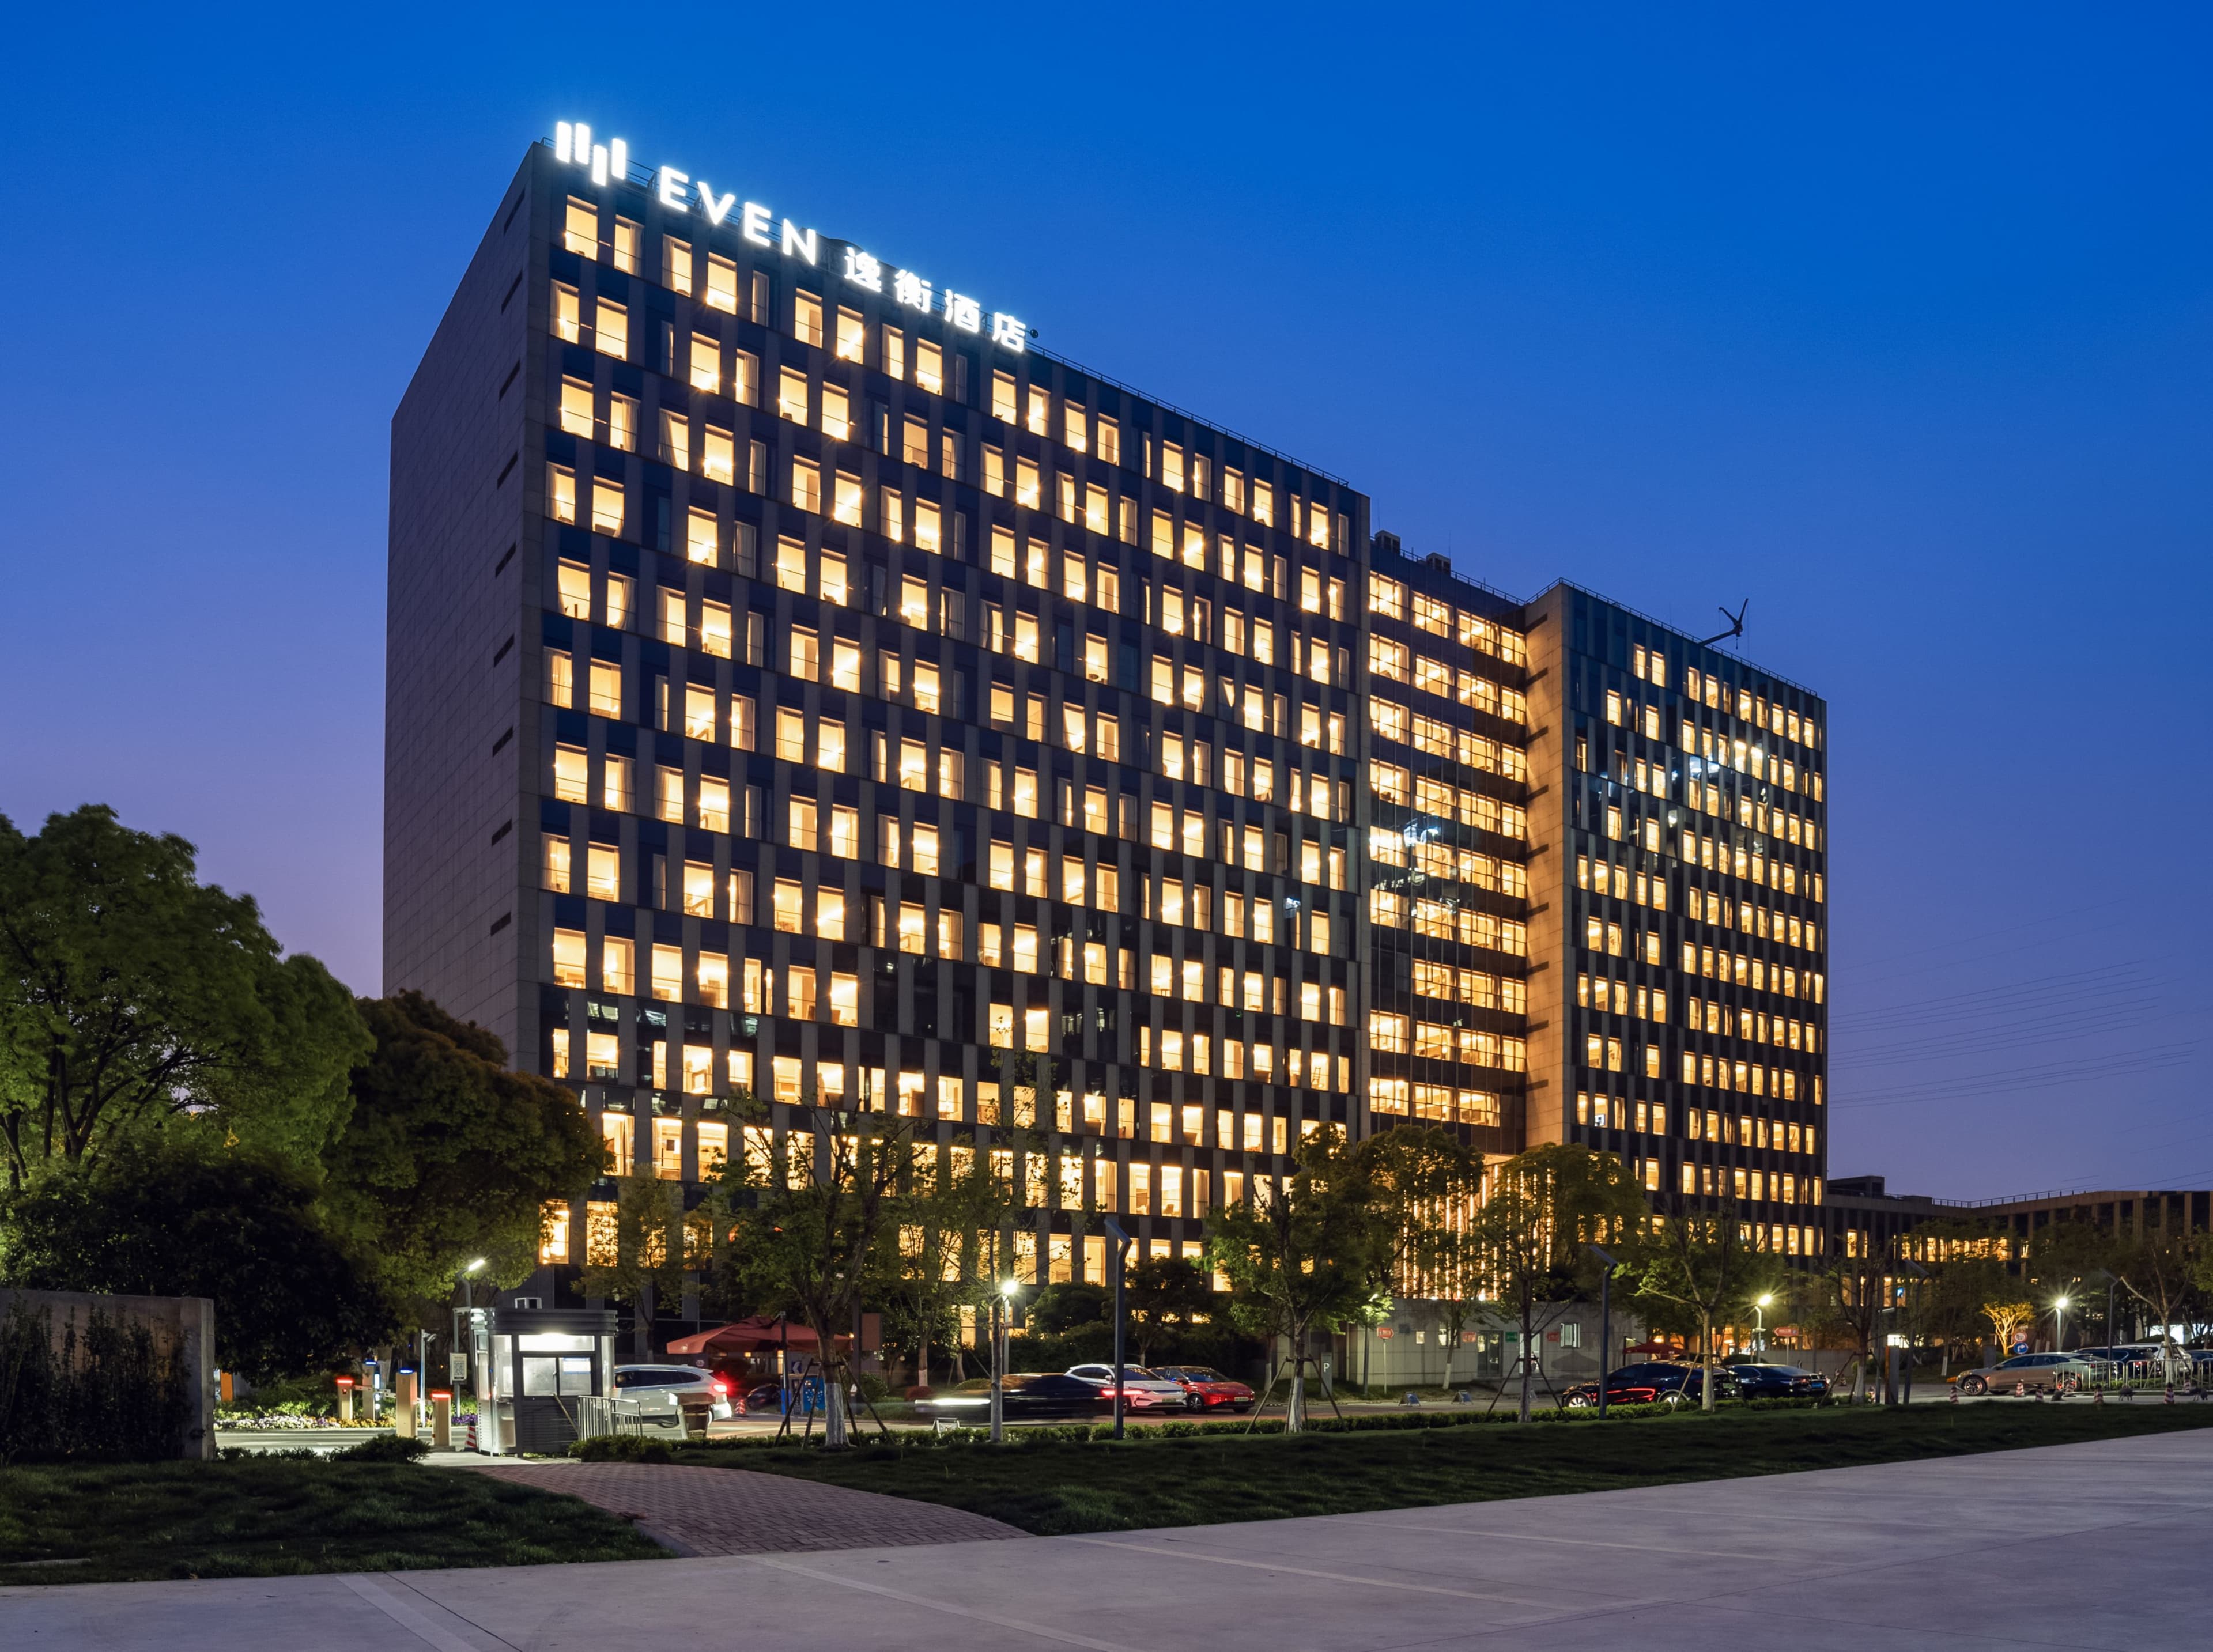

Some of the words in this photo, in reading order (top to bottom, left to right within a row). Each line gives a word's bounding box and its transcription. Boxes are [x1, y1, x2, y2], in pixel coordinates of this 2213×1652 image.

[659, 165, 817, 266] EVEN
[843, 246, 1027, 353] 逸衡酒店
[1323, 1363, 1330, 1373] P
